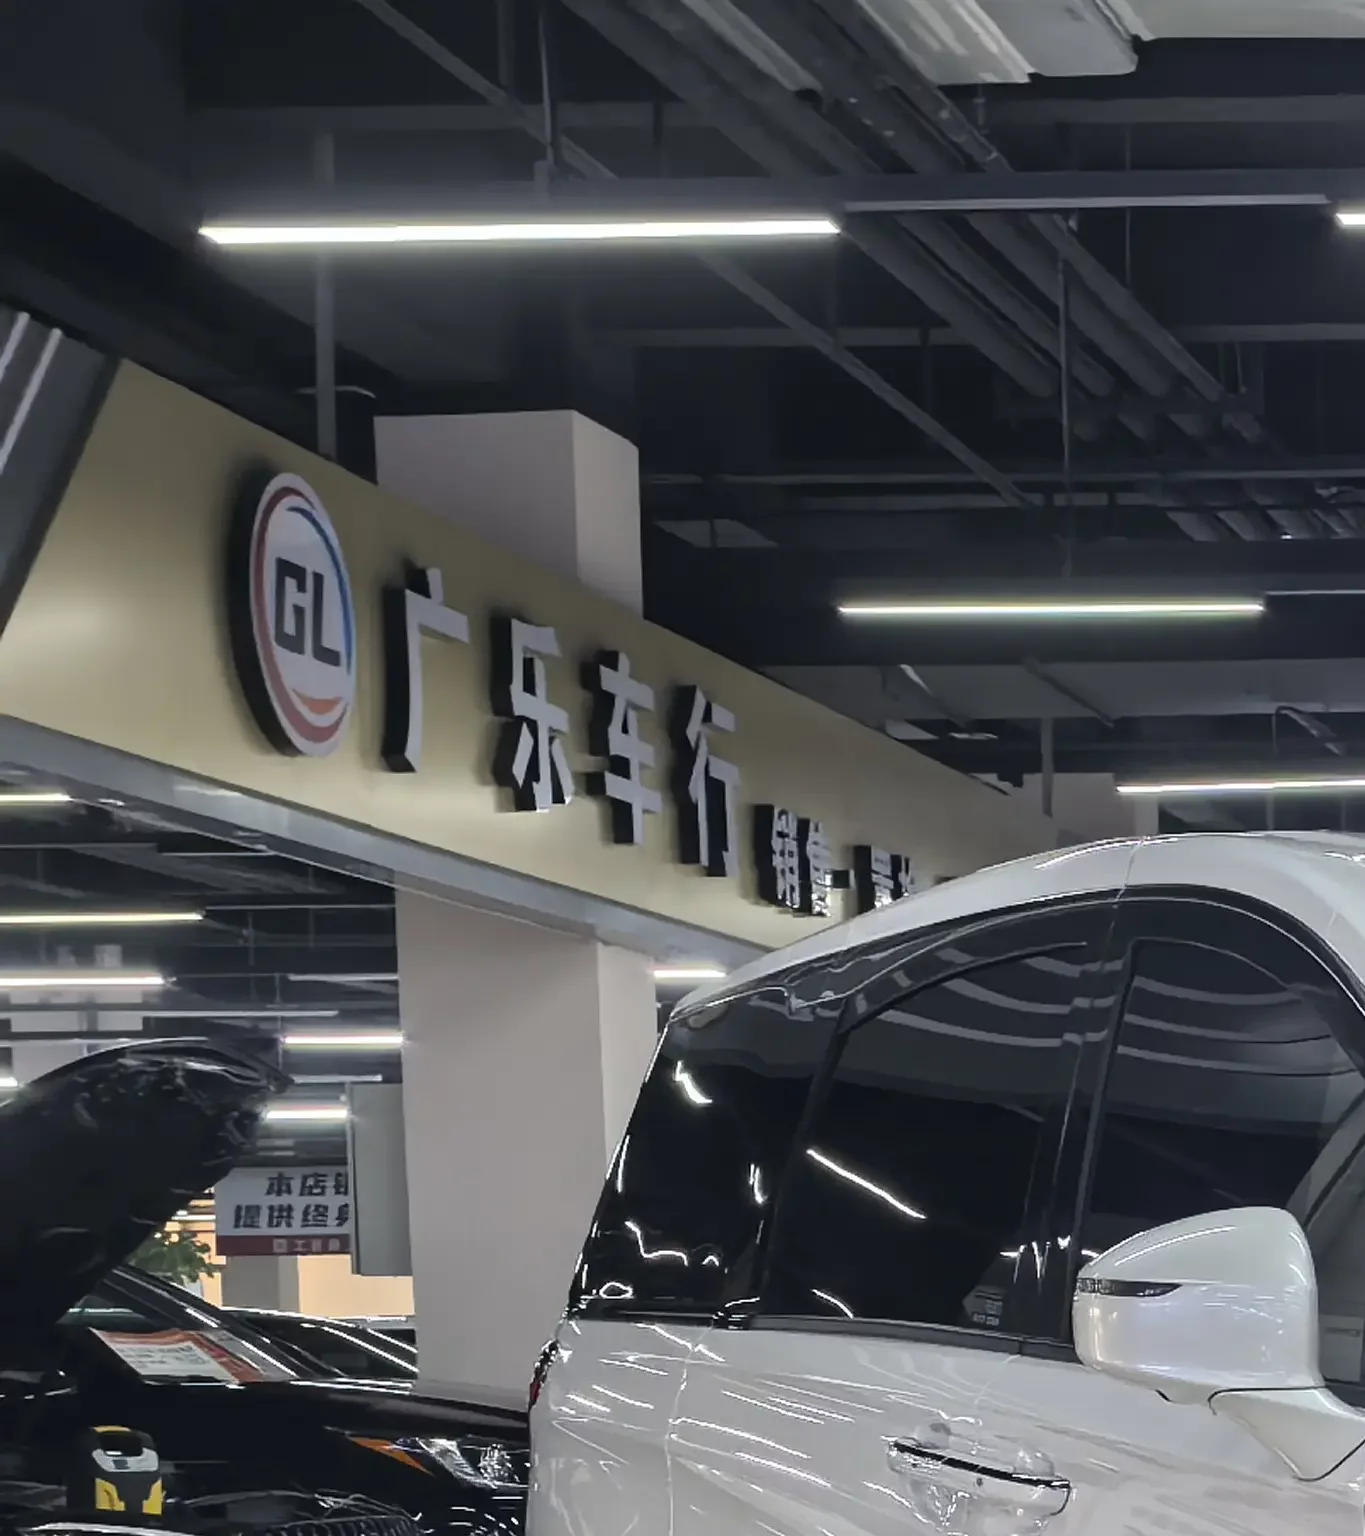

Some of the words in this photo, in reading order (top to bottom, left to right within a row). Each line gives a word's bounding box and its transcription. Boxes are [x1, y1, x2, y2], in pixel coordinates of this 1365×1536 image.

[273, 556, 342, 667] GL
[392, 567, 742, 878] 广乐车行
